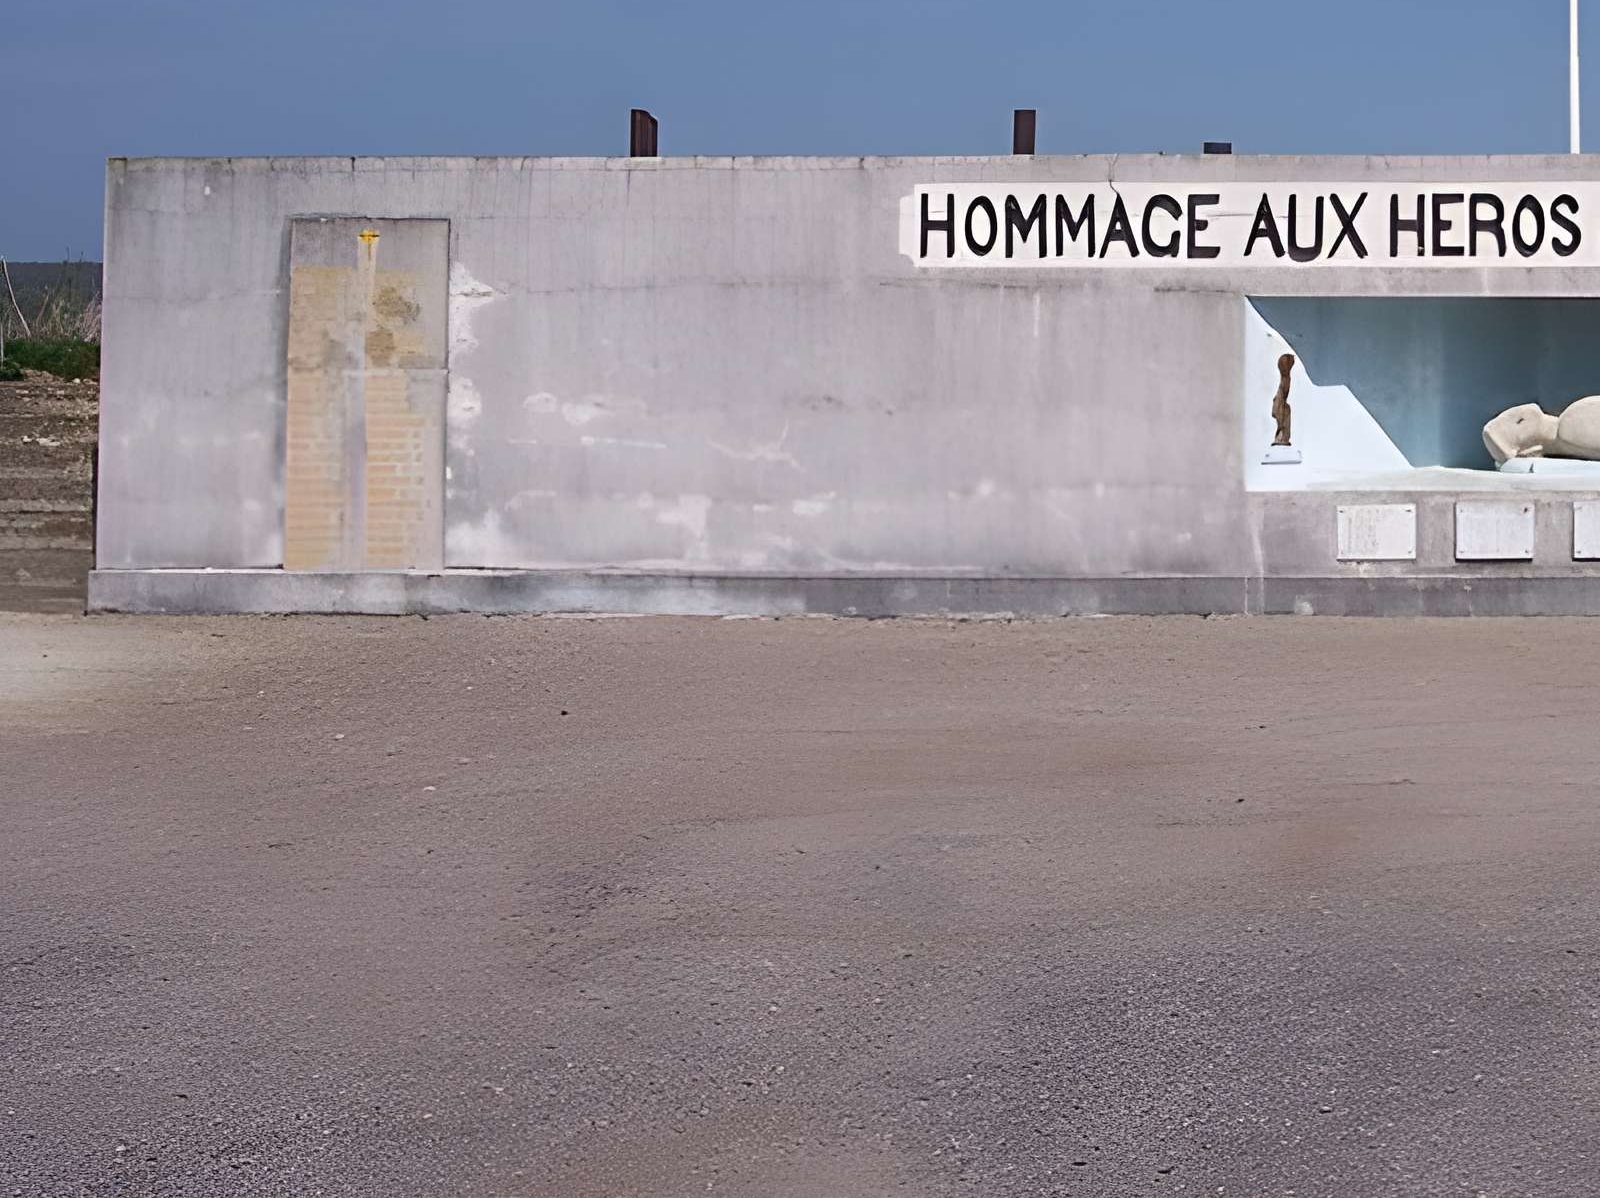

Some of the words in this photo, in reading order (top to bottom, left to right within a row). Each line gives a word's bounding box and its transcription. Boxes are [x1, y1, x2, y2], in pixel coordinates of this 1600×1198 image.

[919, 191, 1221, 259] HOMMAGE
[1243, 191, 1369, 263] AUX
[1388, 192, 1582, 258] HEROS
